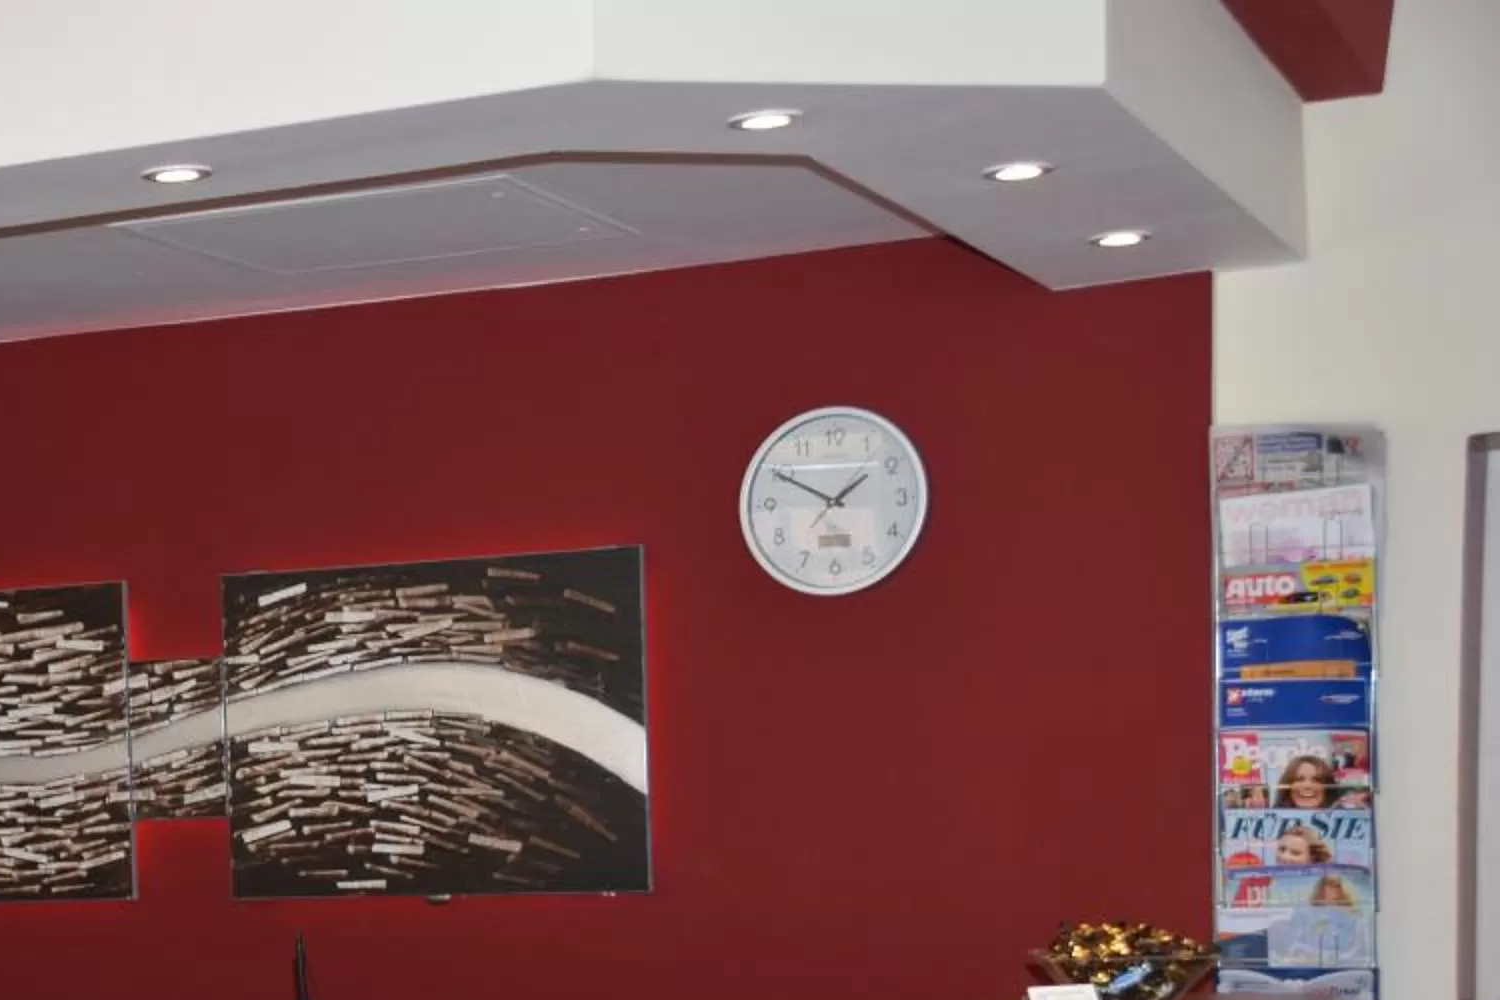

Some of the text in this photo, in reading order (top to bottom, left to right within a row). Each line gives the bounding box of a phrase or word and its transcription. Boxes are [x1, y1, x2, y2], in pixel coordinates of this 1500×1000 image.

[795, 439, 810, 457] 11
[884, 456, 899, 475] 2
[763, 497, 777, 513] 9
[896, 487, 908, 506] 3
[773, 527, 786, 546] 8
[886, 520, 898, 537] 4
[799, 550, 811, 568] 7
[862, 547, 876, 566] 5
[829, 558, 843, 576] 6
[1310, 812, 1367, 840] SIE
